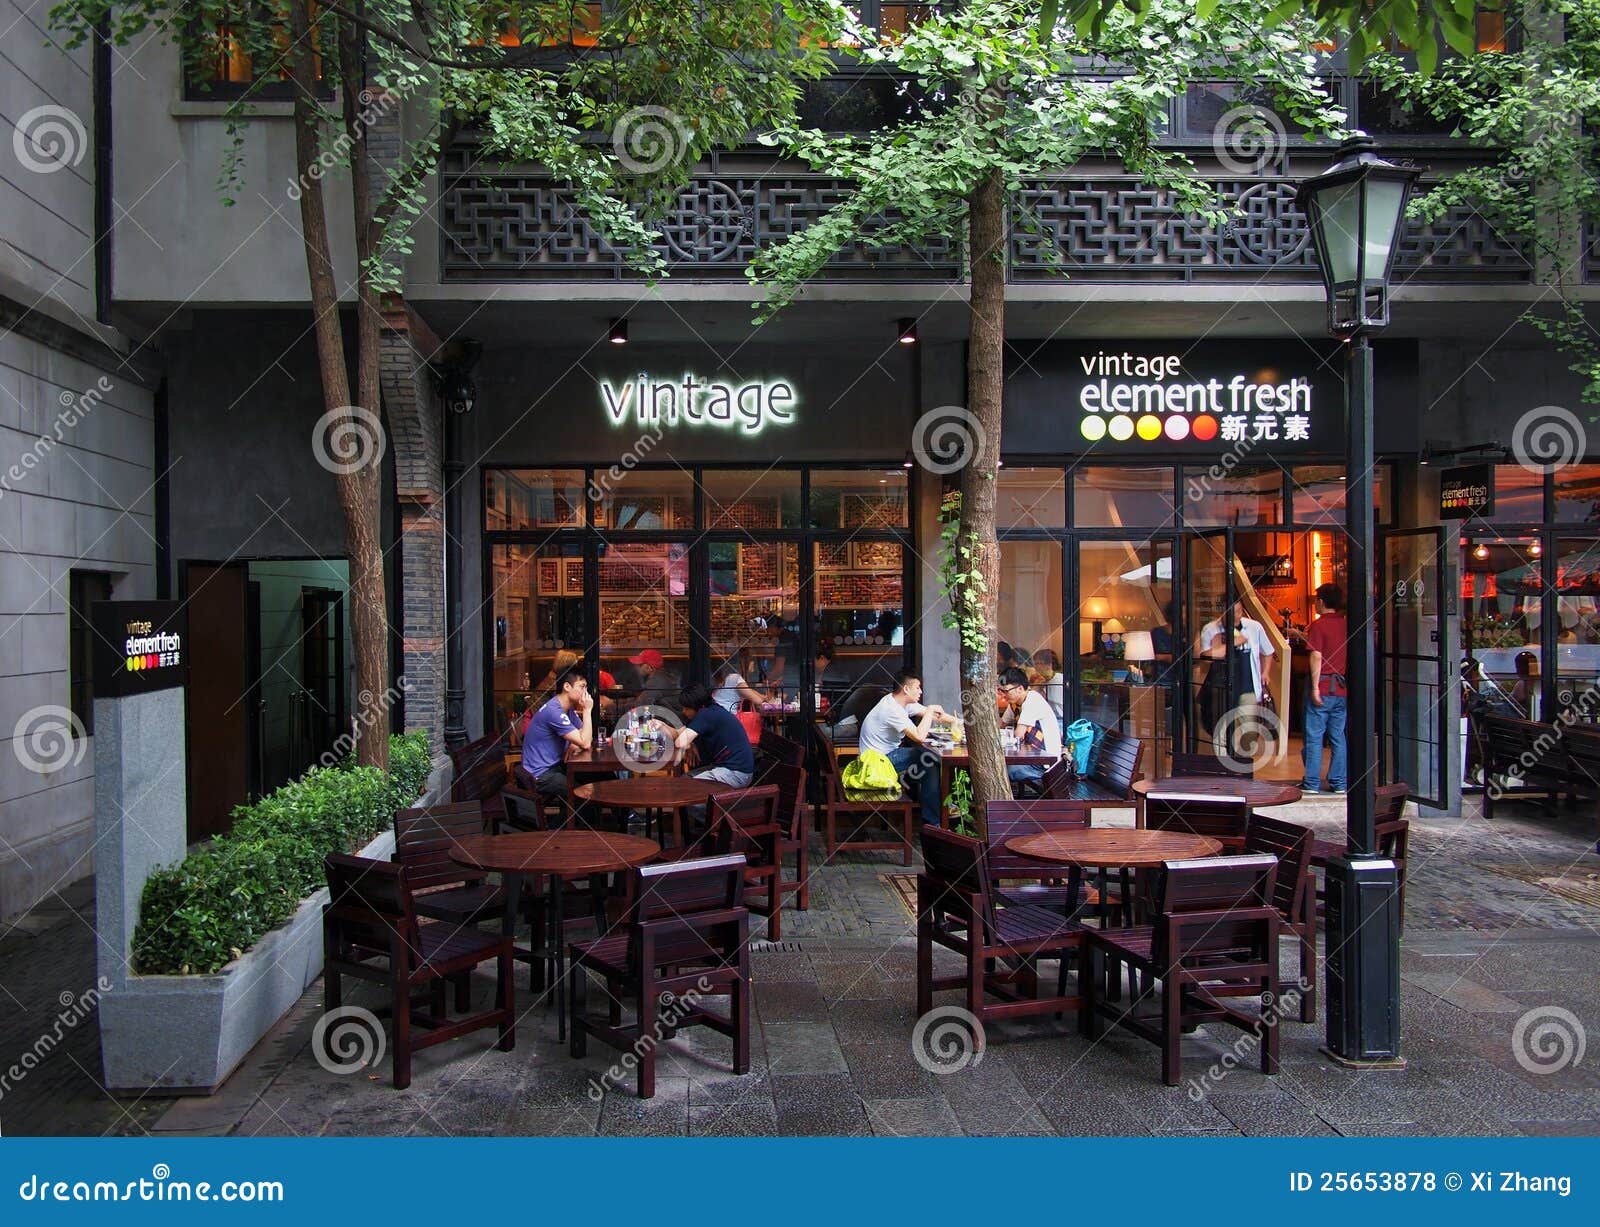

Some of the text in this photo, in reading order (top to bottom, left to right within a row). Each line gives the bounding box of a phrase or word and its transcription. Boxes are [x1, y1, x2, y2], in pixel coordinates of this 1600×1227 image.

[1080, 351, 1181, 381] vintage
[601, 374, 794, 431] vintage
[1080, 376, 1311, 413] element fresh
[1221, 415, 1310, 441] 新元素
[126, 620, 152, 636] vintage
[126, 631, 180, 655] element fresh
[159, 652, 180, 667] 新元素
